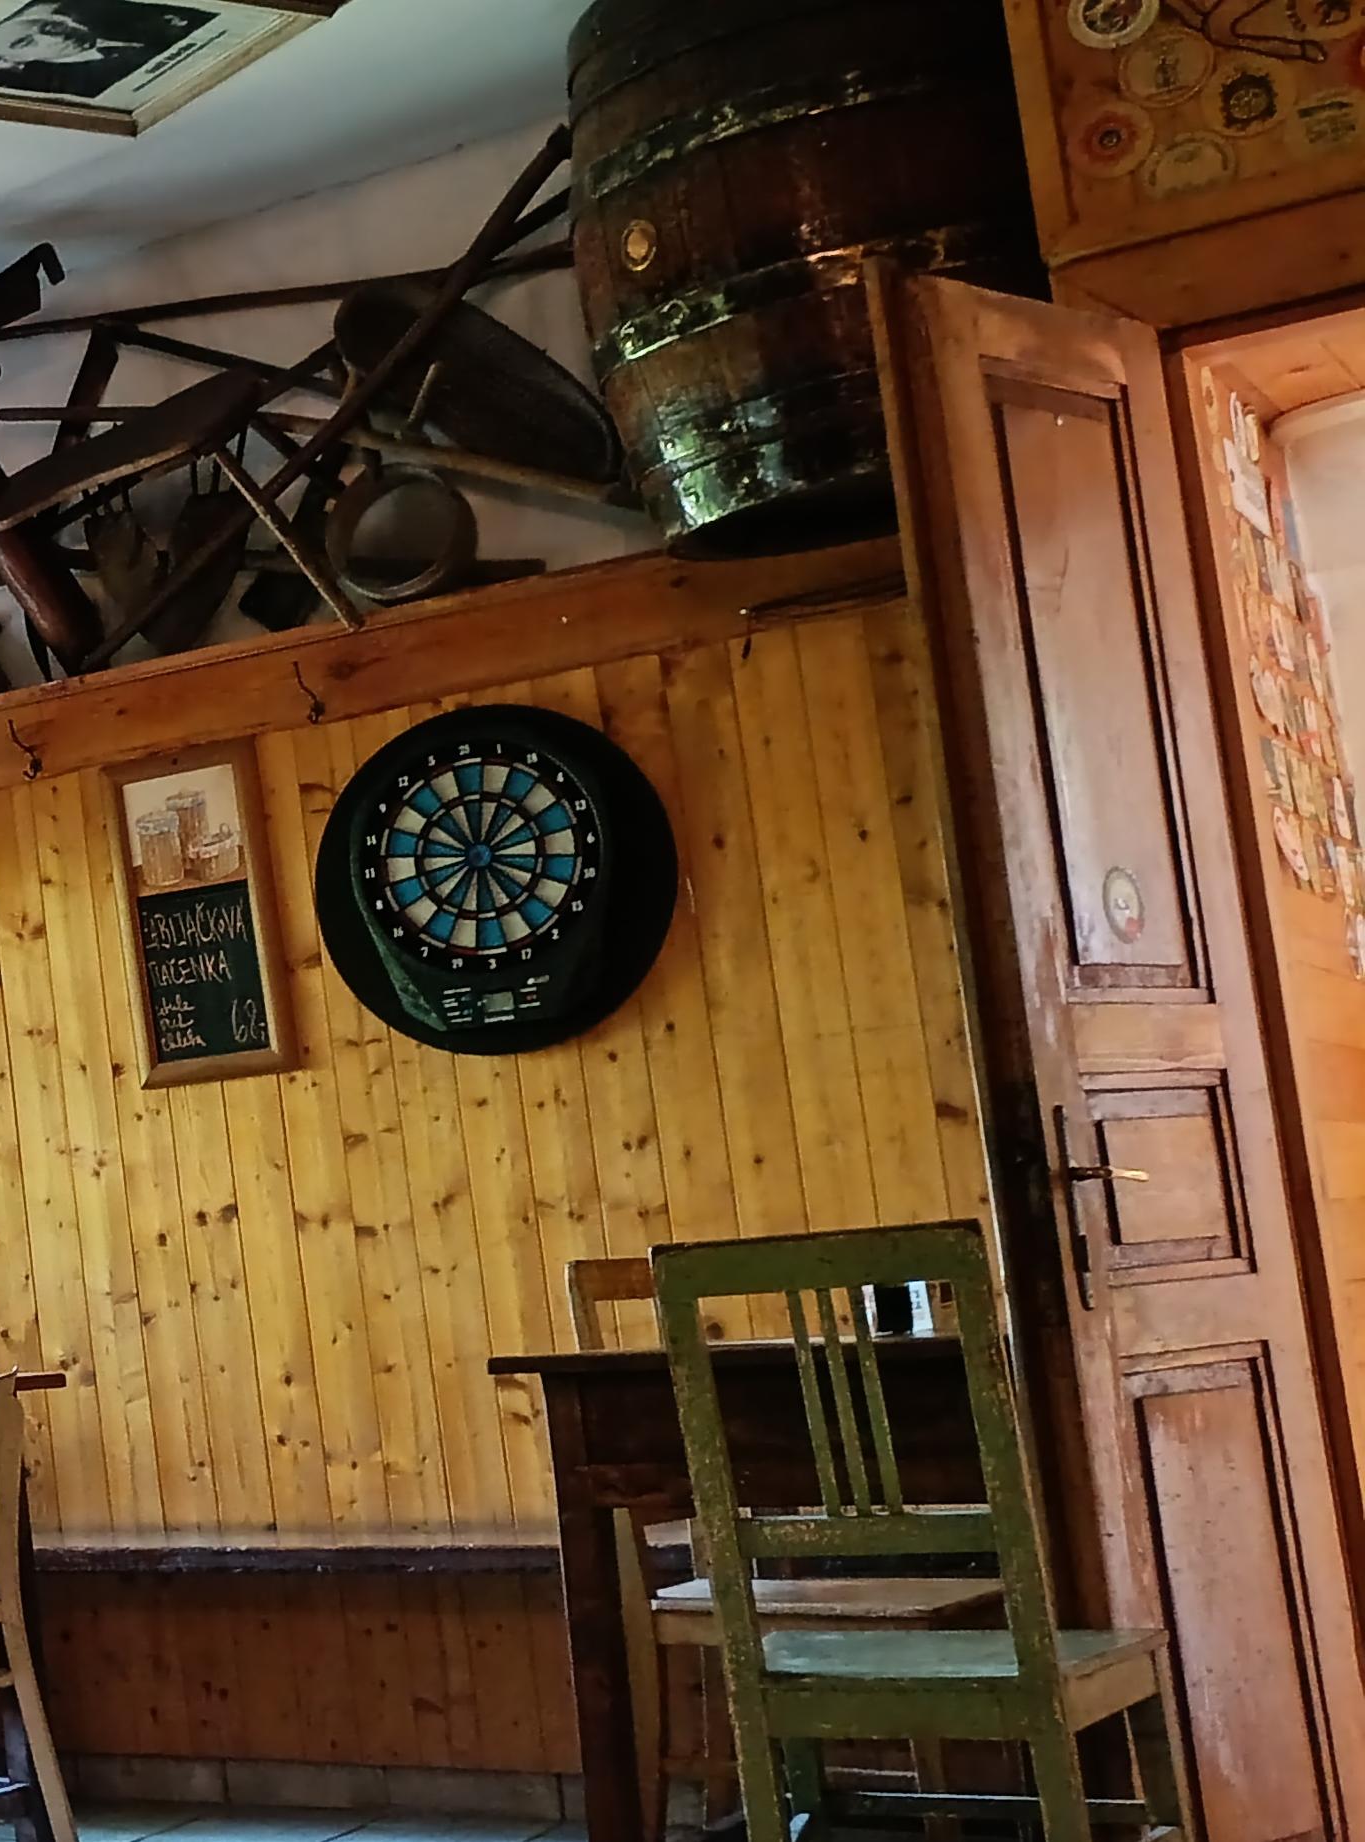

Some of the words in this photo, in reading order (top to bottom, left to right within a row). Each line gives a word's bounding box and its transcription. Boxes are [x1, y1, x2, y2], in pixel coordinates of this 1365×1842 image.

[496, 743, 502, 754] 1
[398, 775, 409, 787] 12
[556, 772, 565, 783] 4
[379, 803, 387, 813] 9
[586, 831, 596, 844] 6
[365, 867, 376, 879] 11
[393, 926, 404, 938] 16
[551, 928, 560, 940] 2
[420, 946, 429, 958] 7
[521, 947, 532, 960] 17
[487, 958, 497, 970] 3
